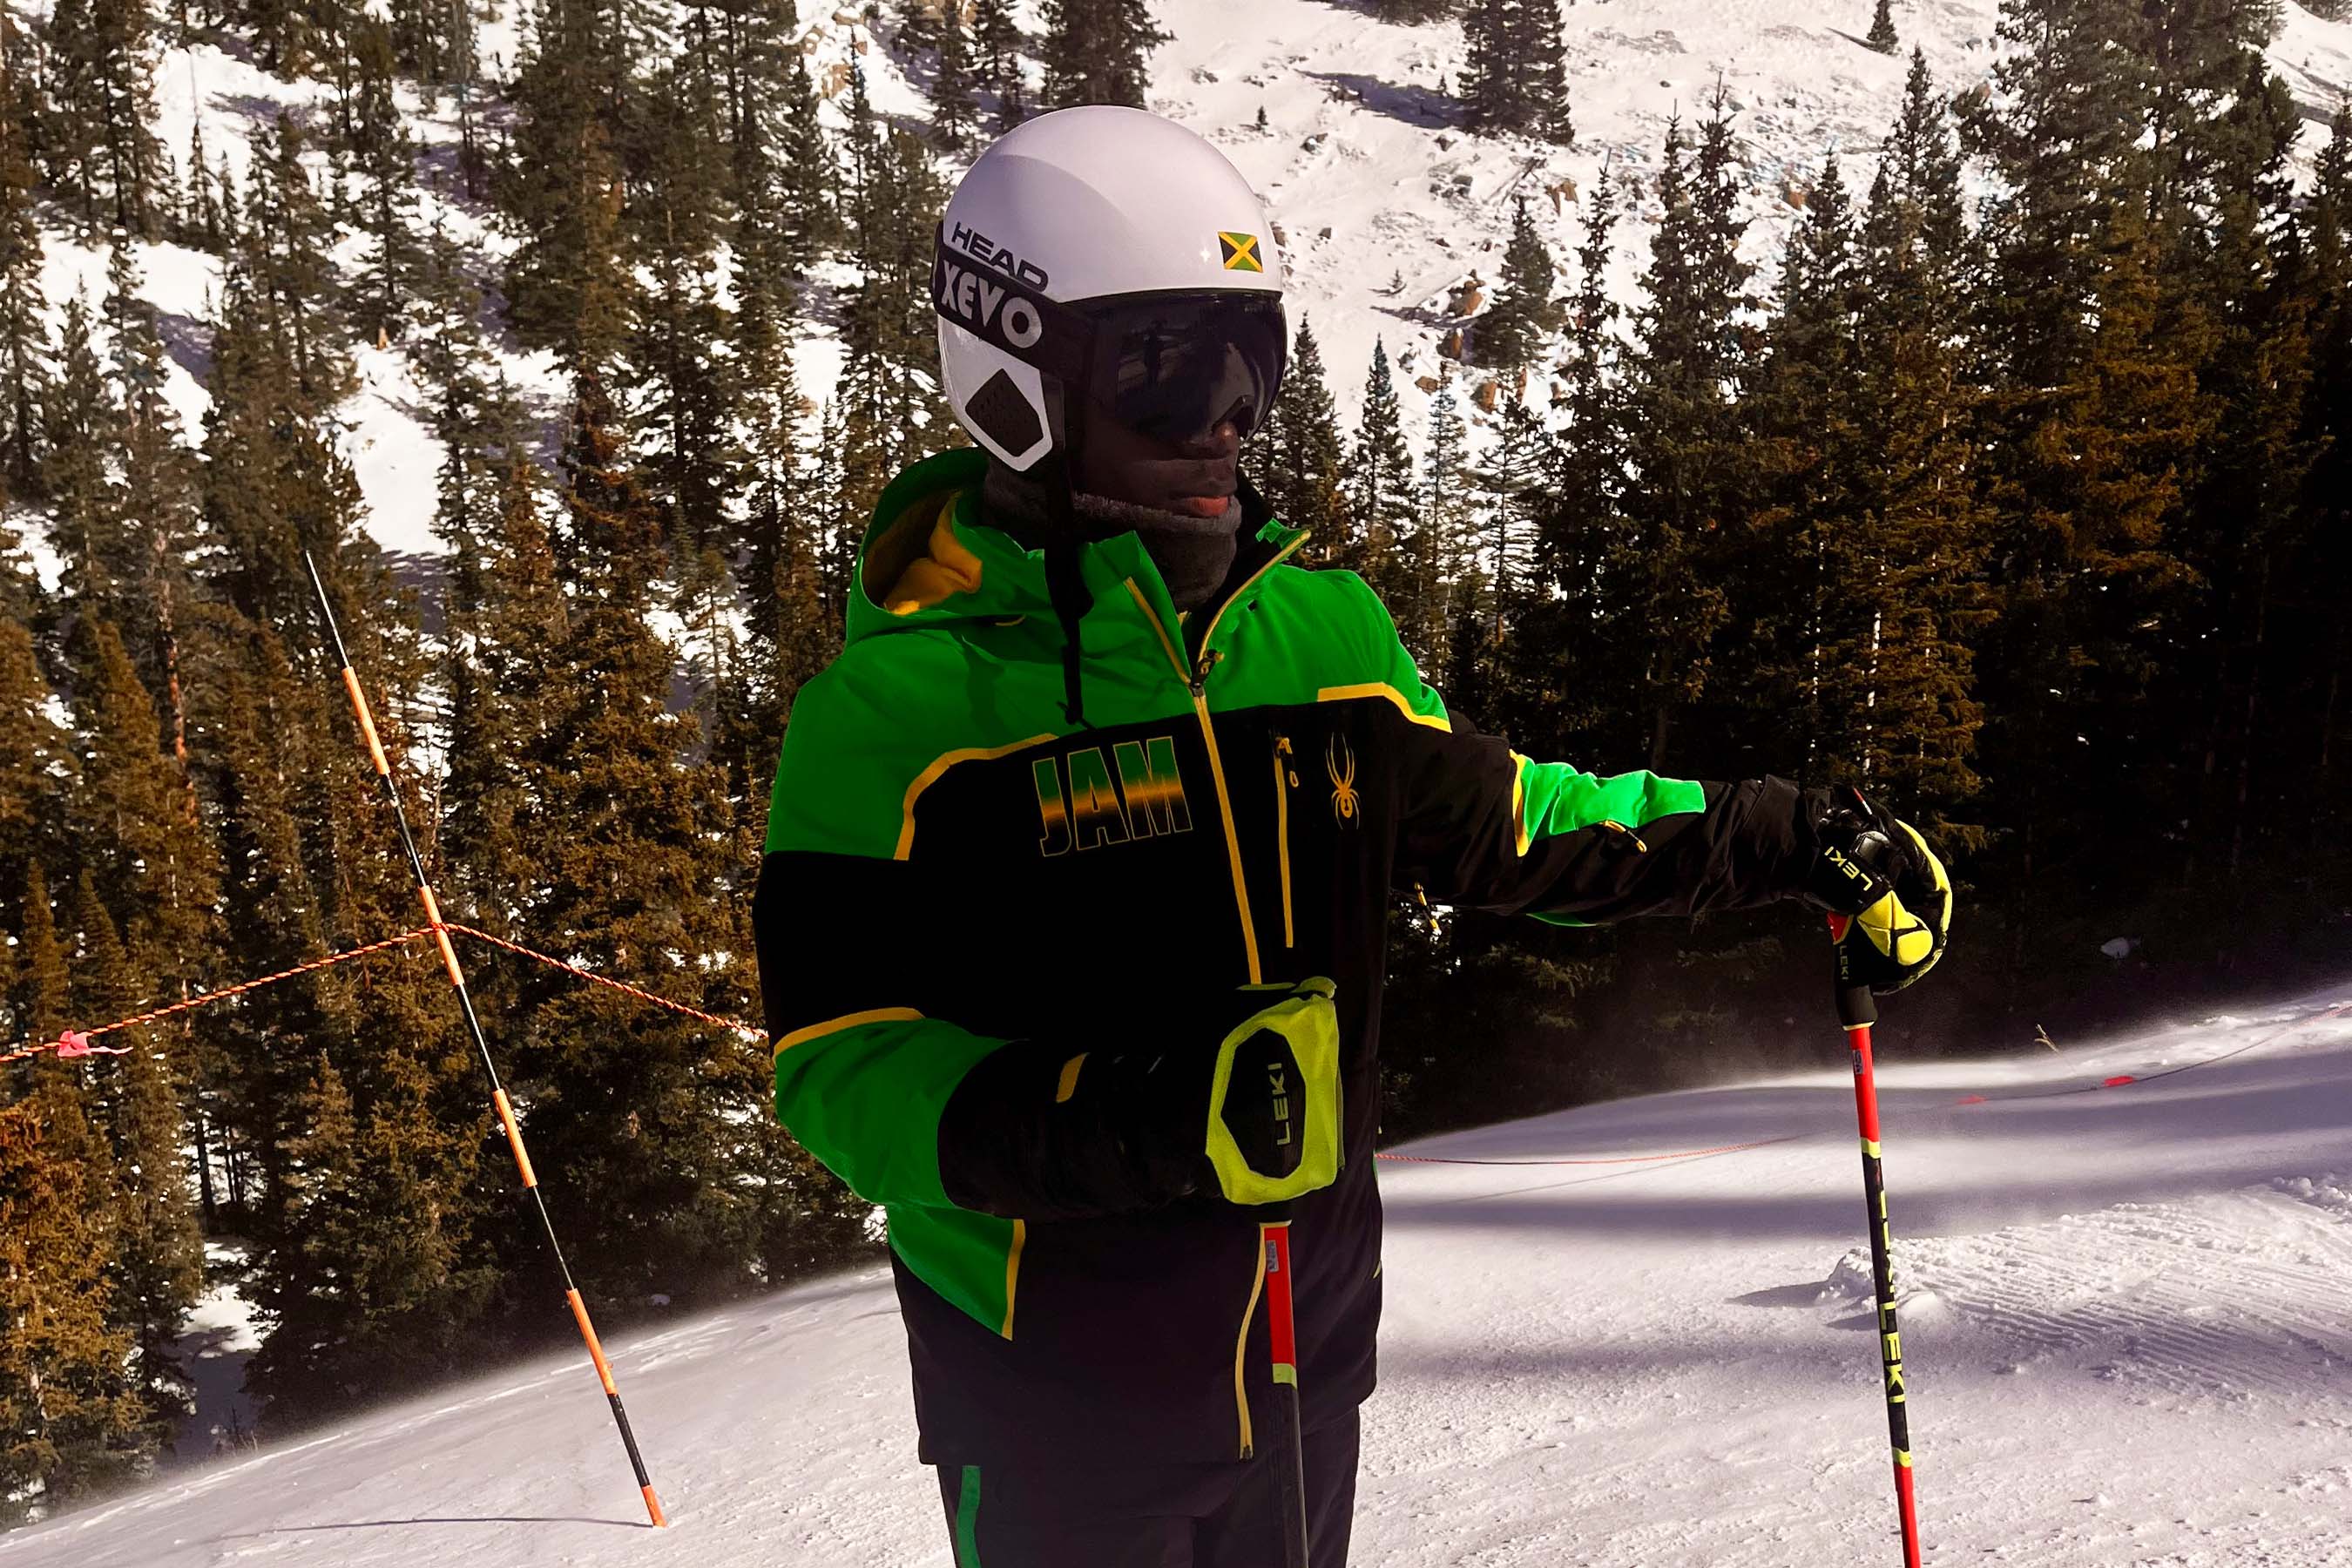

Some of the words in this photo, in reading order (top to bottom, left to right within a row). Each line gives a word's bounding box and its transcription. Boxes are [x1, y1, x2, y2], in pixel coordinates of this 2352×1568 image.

[951, 221, 1049, 292] HEAD
[941, 260, 1043, 348] XEVO
[1032, 736, 1193, 857] JAM
[1824, 846, 1873, 891] LEKI
[1839, 945, 1848, 980] LEKI
[1267, 1063, 1291, 1146] LEKI
[1879, 1301, 1905, 1402] LEKI
